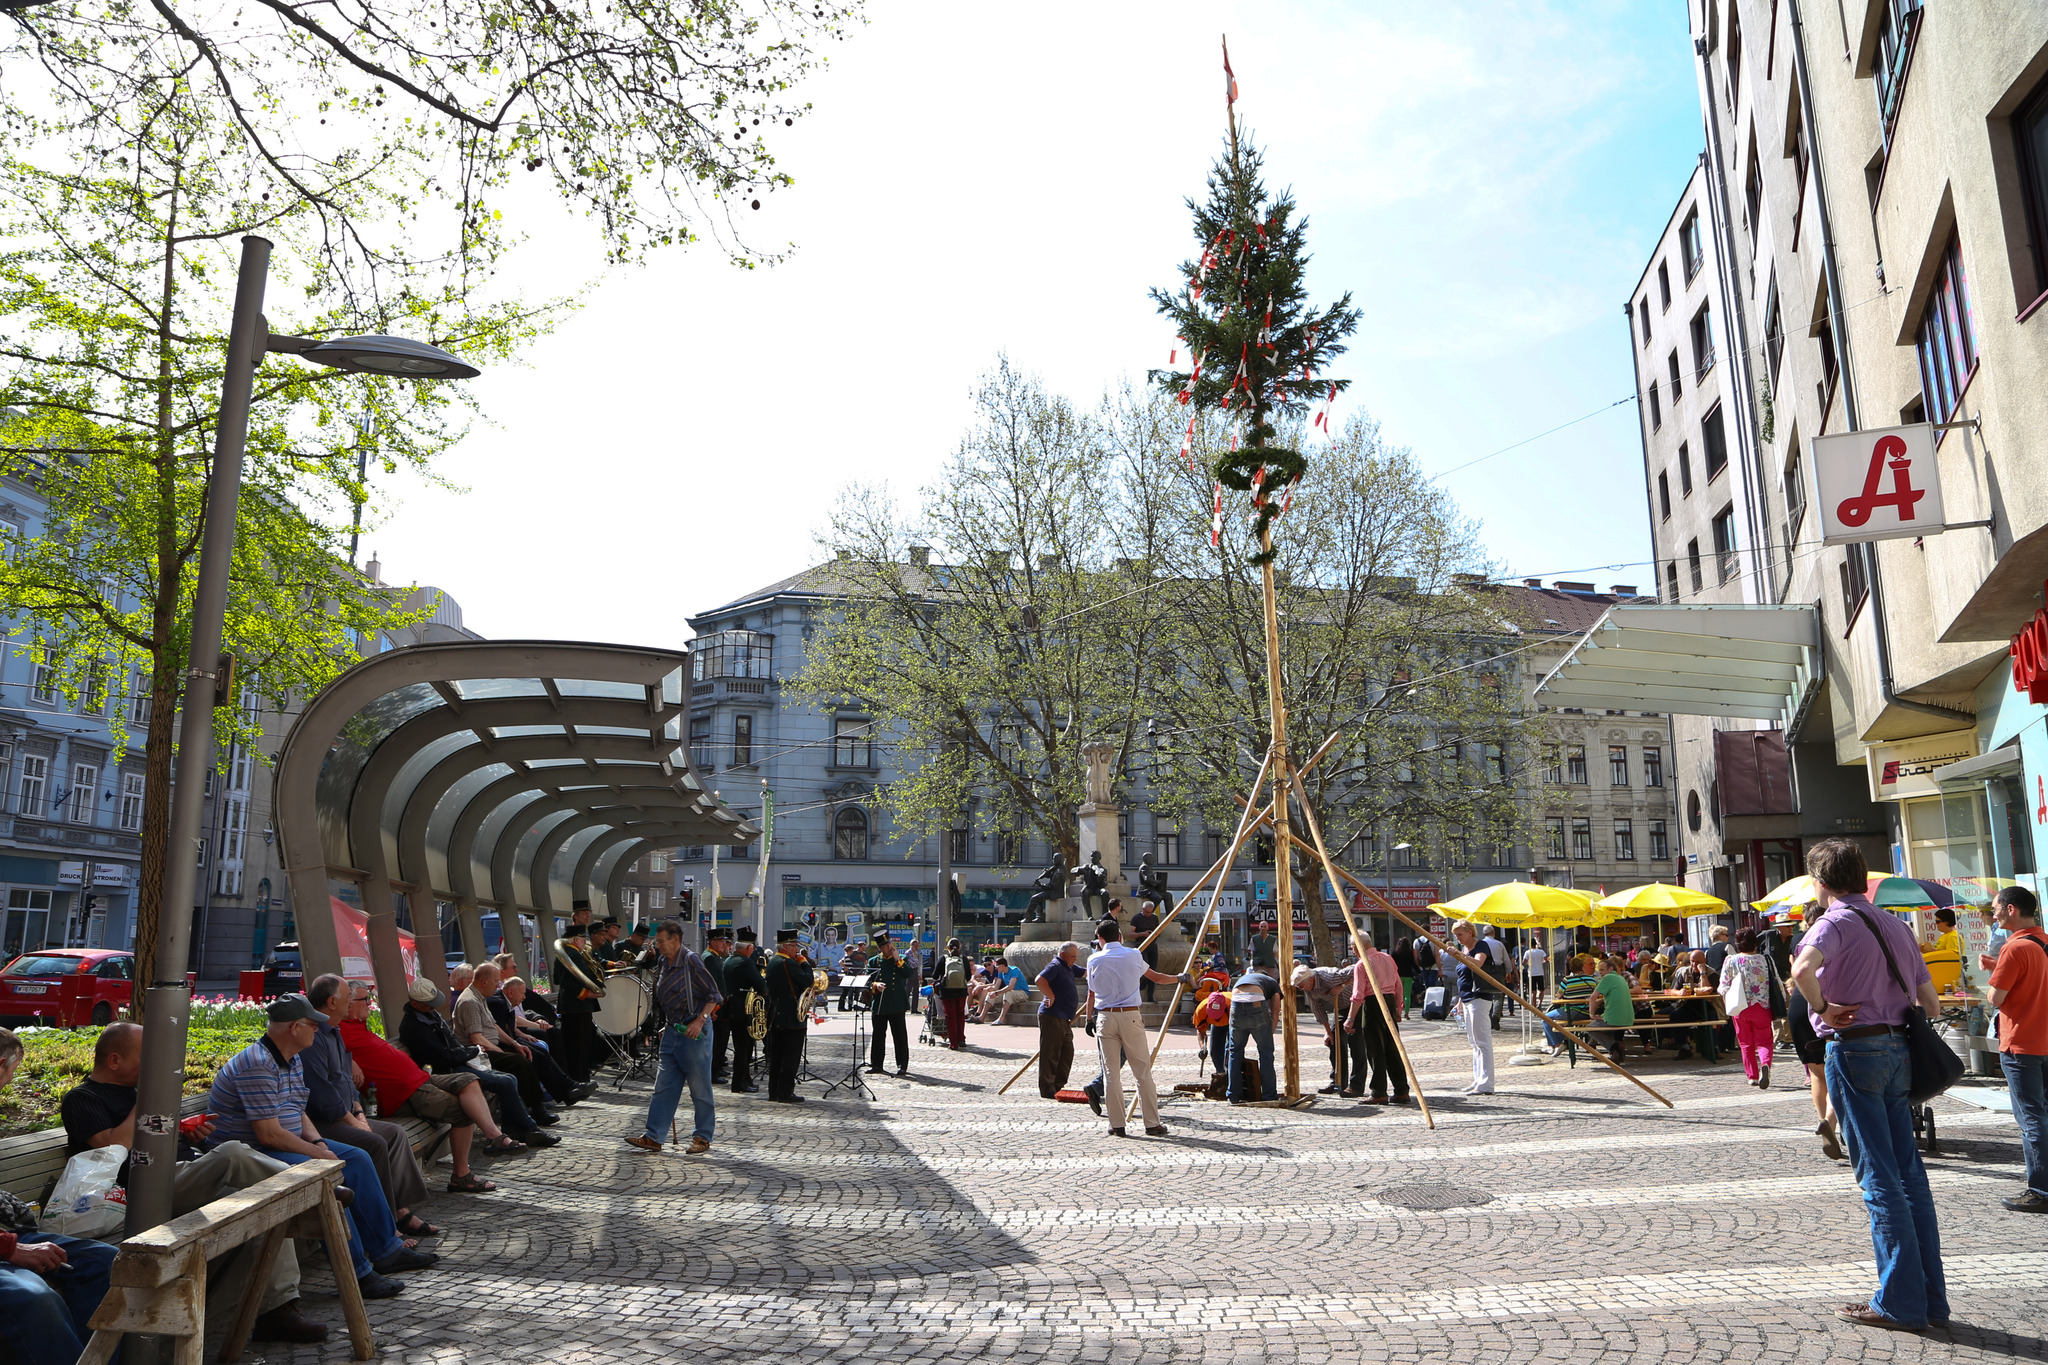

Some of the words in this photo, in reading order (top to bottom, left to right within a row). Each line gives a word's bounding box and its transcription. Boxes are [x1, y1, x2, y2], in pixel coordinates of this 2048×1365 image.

[1182, 897, 1242, 907] EUOTH
[1968, 921, 1986, 930] 19.00
[1927, 933, 1935, 942] FR
[1970, 932, 1987, 941] 19.00
